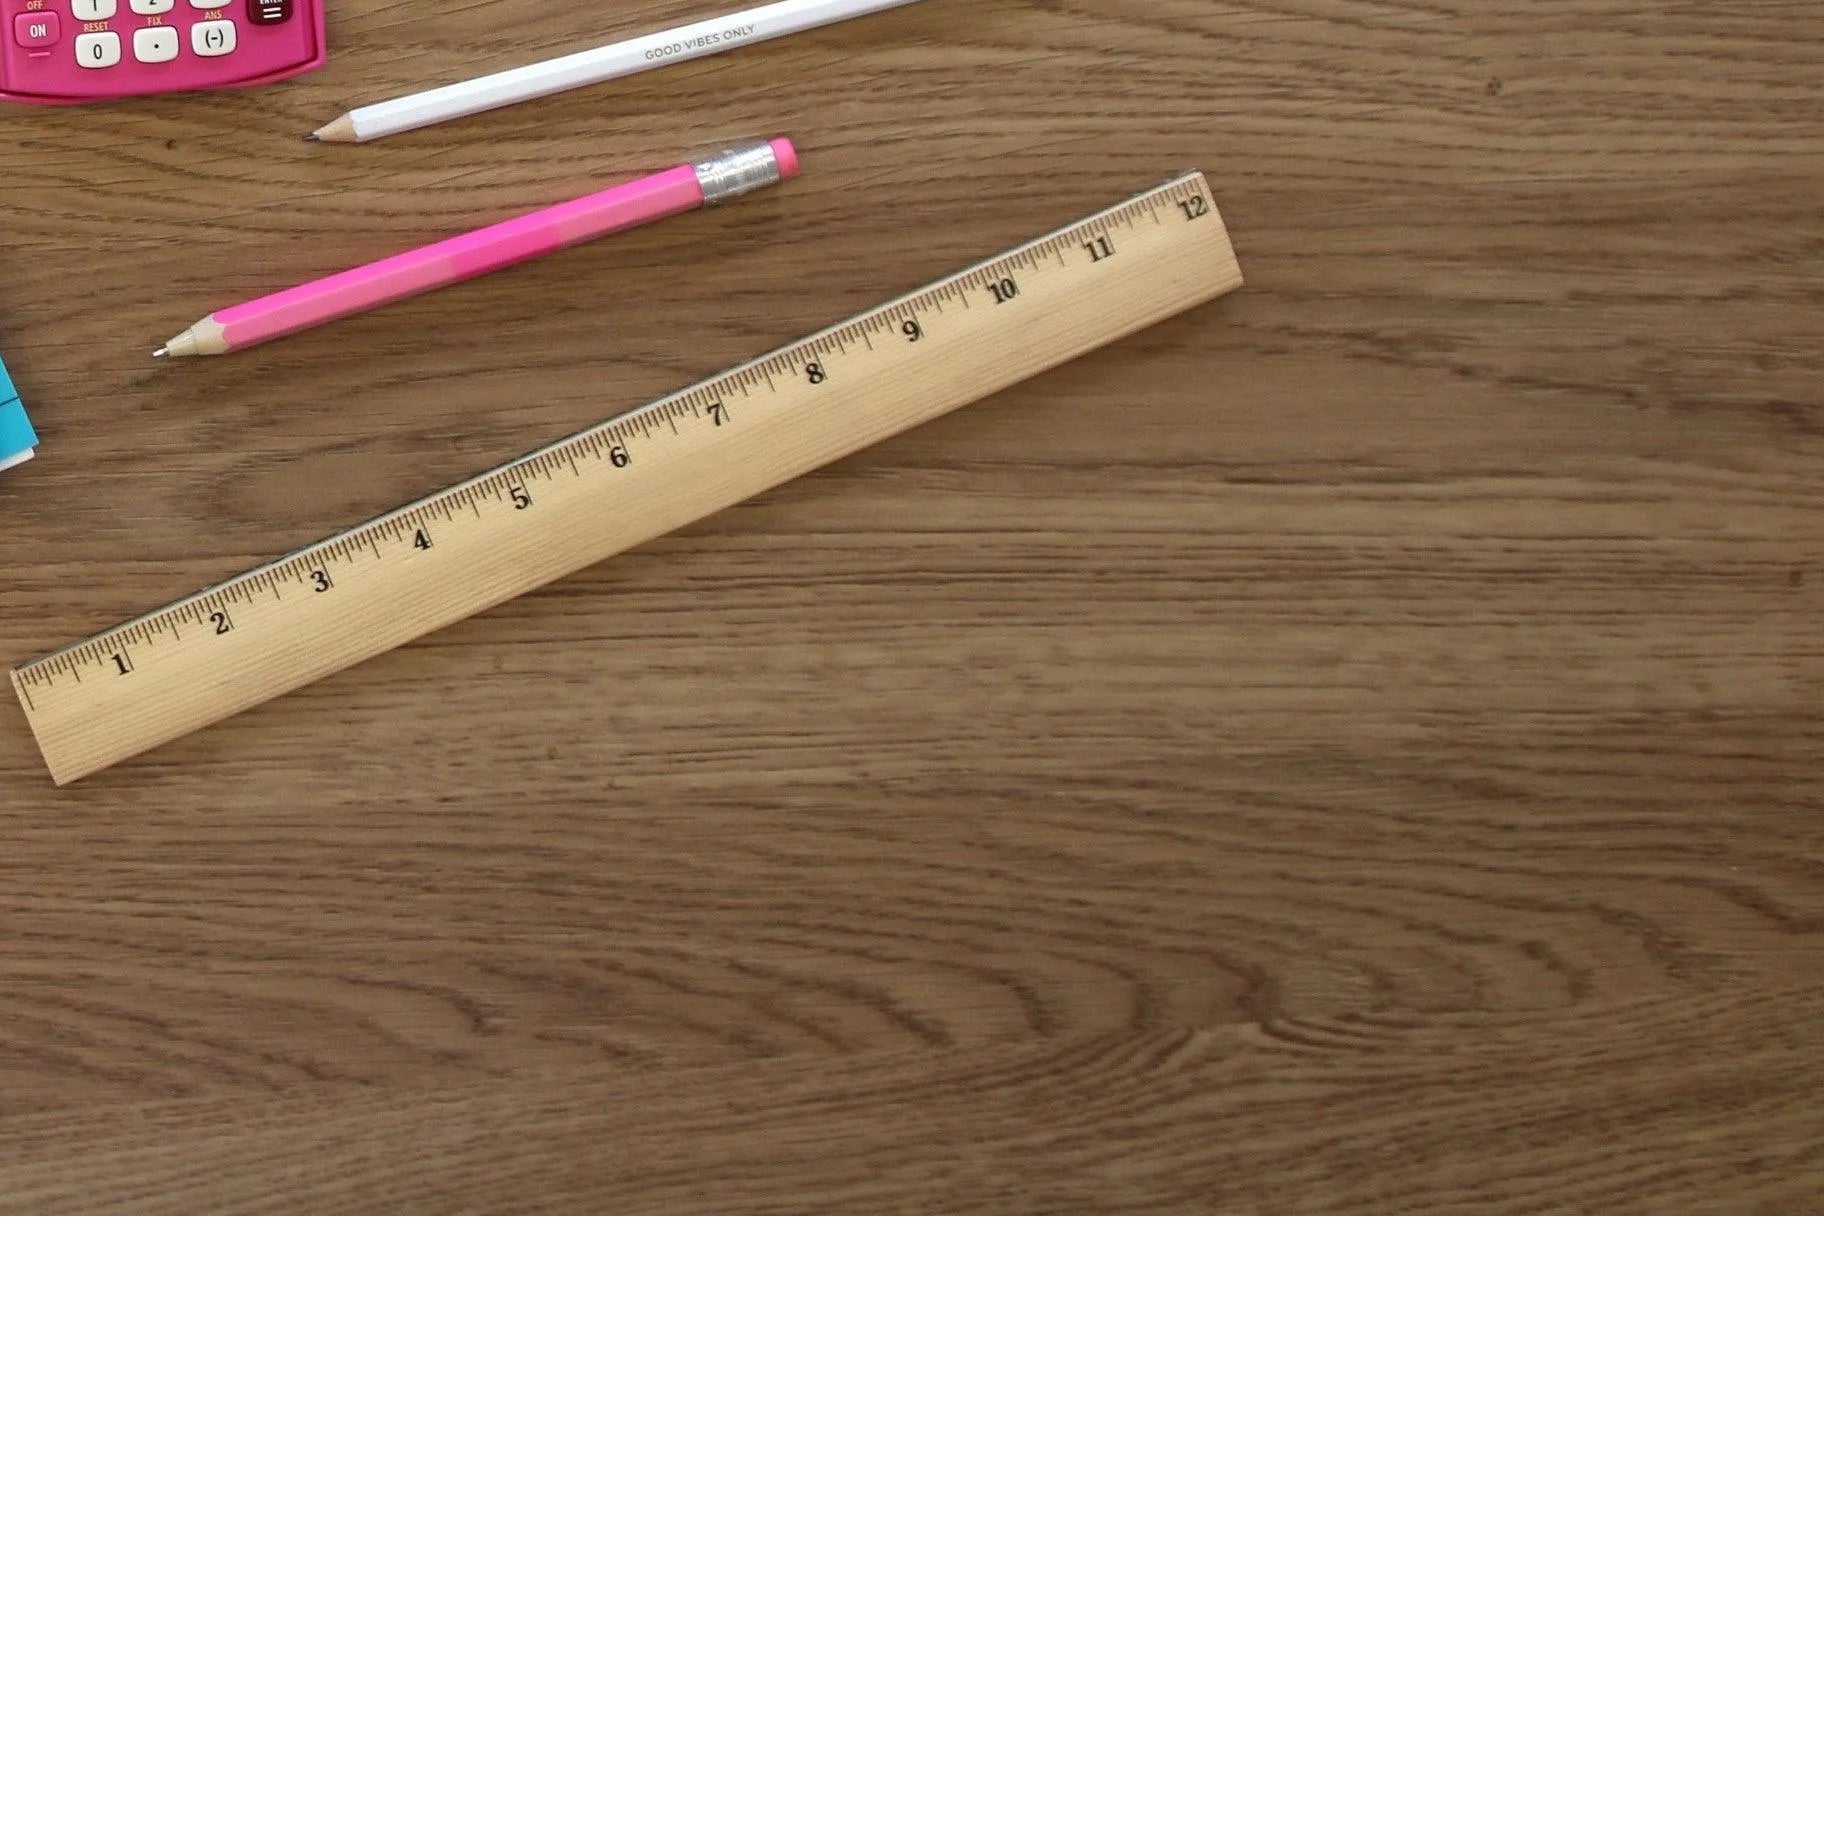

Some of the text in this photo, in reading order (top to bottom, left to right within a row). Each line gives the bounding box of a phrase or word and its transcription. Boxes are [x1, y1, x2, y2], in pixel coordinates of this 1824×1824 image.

[26, 0, 43, 11] OFF
[147, 15, 163, 26] FIX
[204, 10, 222, 20] ANS
[29, 23, 47, 38] ON
[83, 21, 109, 33] RESET
[645, 24, 755, 60] GOOD VIBES ONLY
[93, 43, 103, 60] 0
[111, 194, 1207, 676] 1 2 3 4 5 6 7 8 9 10 11 12
